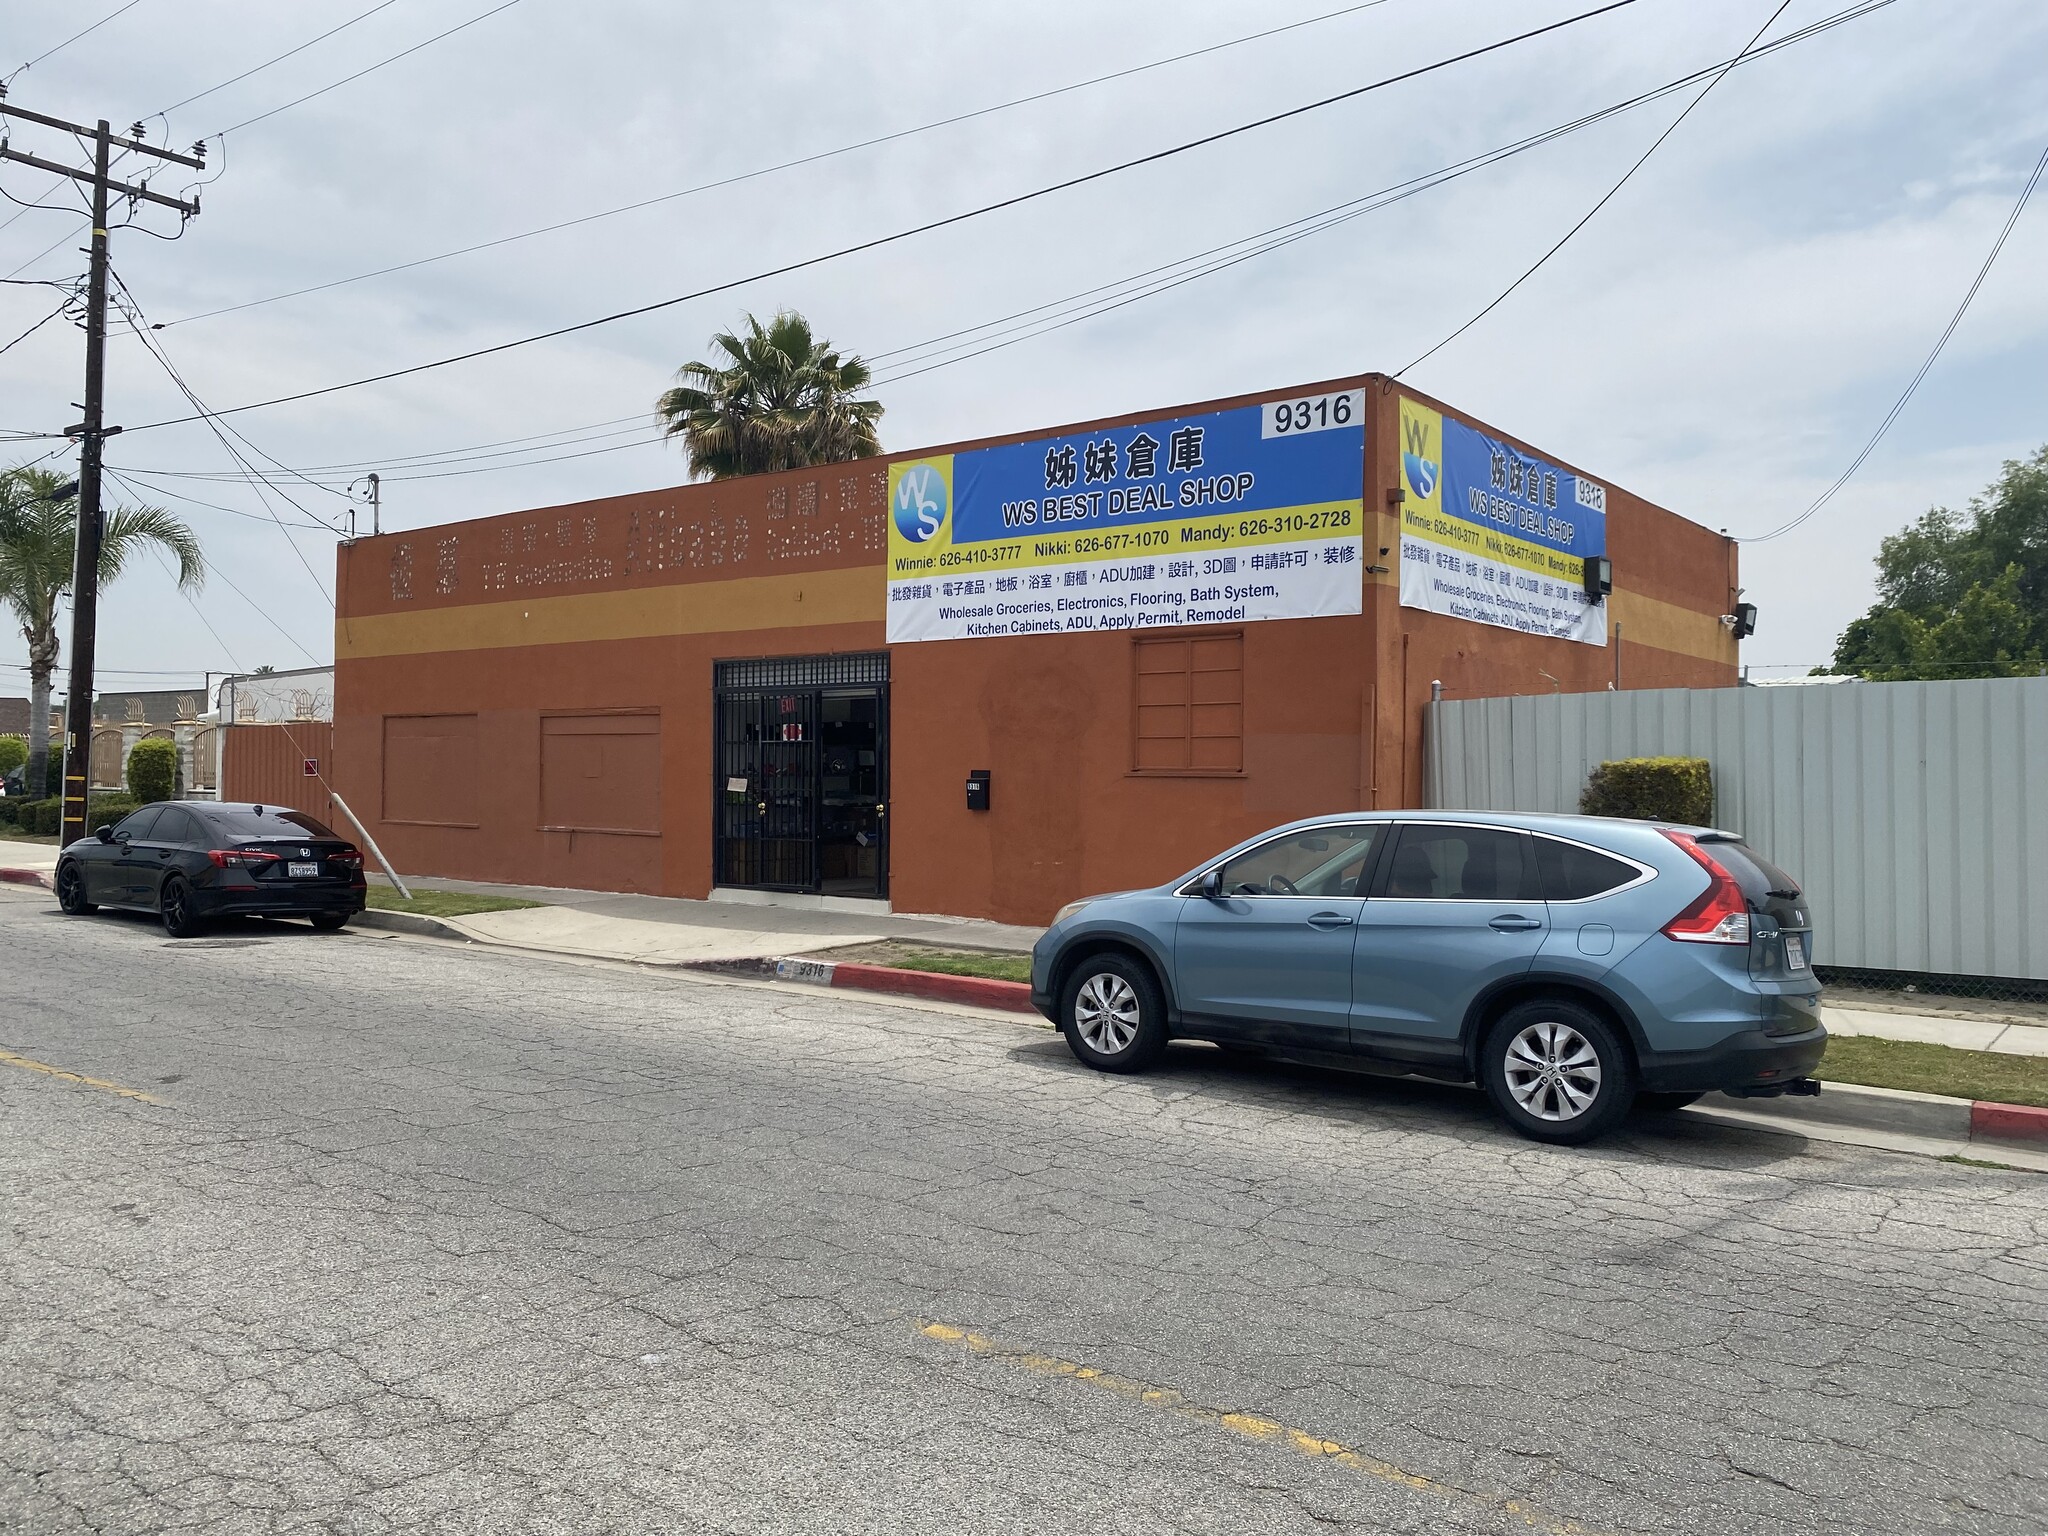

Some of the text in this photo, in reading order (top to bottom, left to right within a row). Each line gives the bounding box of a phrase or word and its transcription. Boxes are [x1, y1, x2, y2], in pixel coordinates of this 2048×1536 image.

[1275, 394, 1351, 433] 9316
[1045, 426, 1204, 489] 姊妹倉庫
[1490, 448, 1557, 509] 姊妹倉庫
[1579, 480, 1602, 509] 9316
[1003, 472, 1254, 527] WS BEST DEAL SHOP
[1469, 487, 1574, 545] WS BEST DEAL SHOP
[895, 510, 1351, 571] Winnie: 626-410-3777 Nikki: 626-677-1070 Mandy: 626-310-2728
[1405, 509, 1432, 531] Winnie:
[1434, 519, 1479, 546] 626-410-3777
[1486, 536, 1503, 553] Nikki:
[1504, 542, 1545, 566] 626-677-1070
[1549, 556, 1567, 575] Mandy:
[939, 584, 1279, 619] Wholesale Groceries, Electronics, Flooring, Bath System,
[1433, 578, 1465, 597] Wholesale
[1466, 587, 1495, 604] Groceries,
[1496, 595, 1527, 613] Electronics,
[1528, 602, 1550, 620] Flooring,
[1551, 608, 1563, 619] Bath
[1450, 602, 1472, 618] Kitchen
[1473, 607, 1499, 623] Cabinets,
[1515, 617, 1530, 632] Apply
[967, 605, 1245, 636] Kitchen Cabinets, ADU, Apply Permit, Remodel
[781, 698, 795, 713] EXIT
[800, 963, 825, 977] 9316
